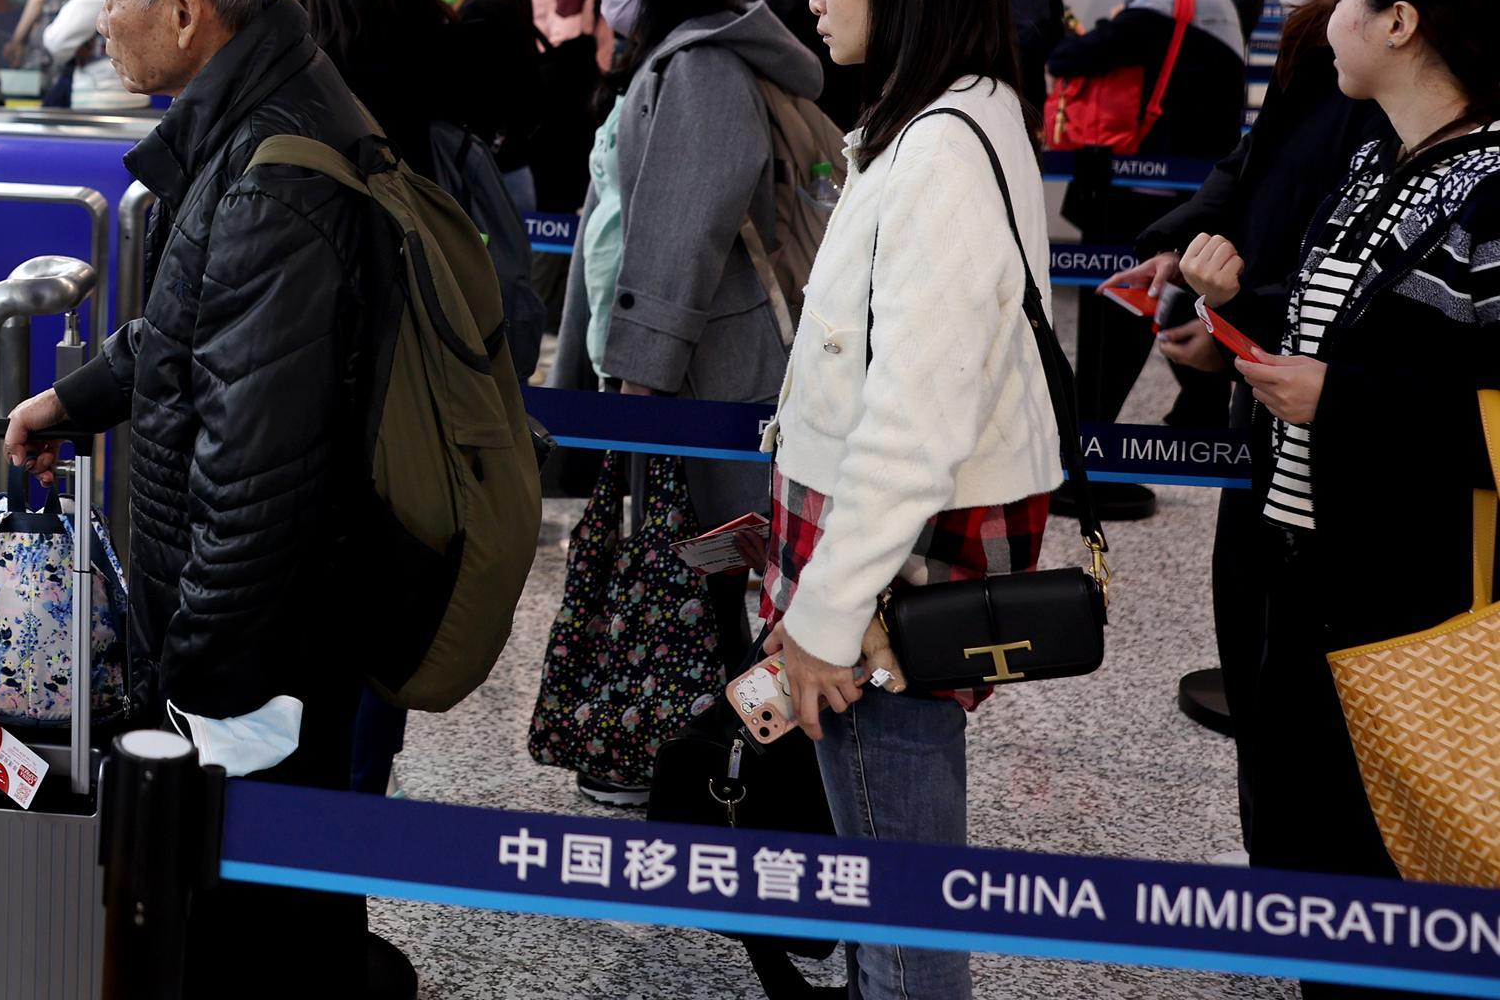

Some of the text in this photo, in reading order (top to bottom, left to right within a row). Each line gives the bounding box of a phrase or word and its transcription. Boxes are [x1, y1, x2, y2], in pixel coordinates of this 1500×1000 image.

[1051, 252, 1140, 271] IGRATIO
[498, 827, 871, 907] 中国移民管理
[941, 868, 1500, 955] CHINA IMMIGRATION
